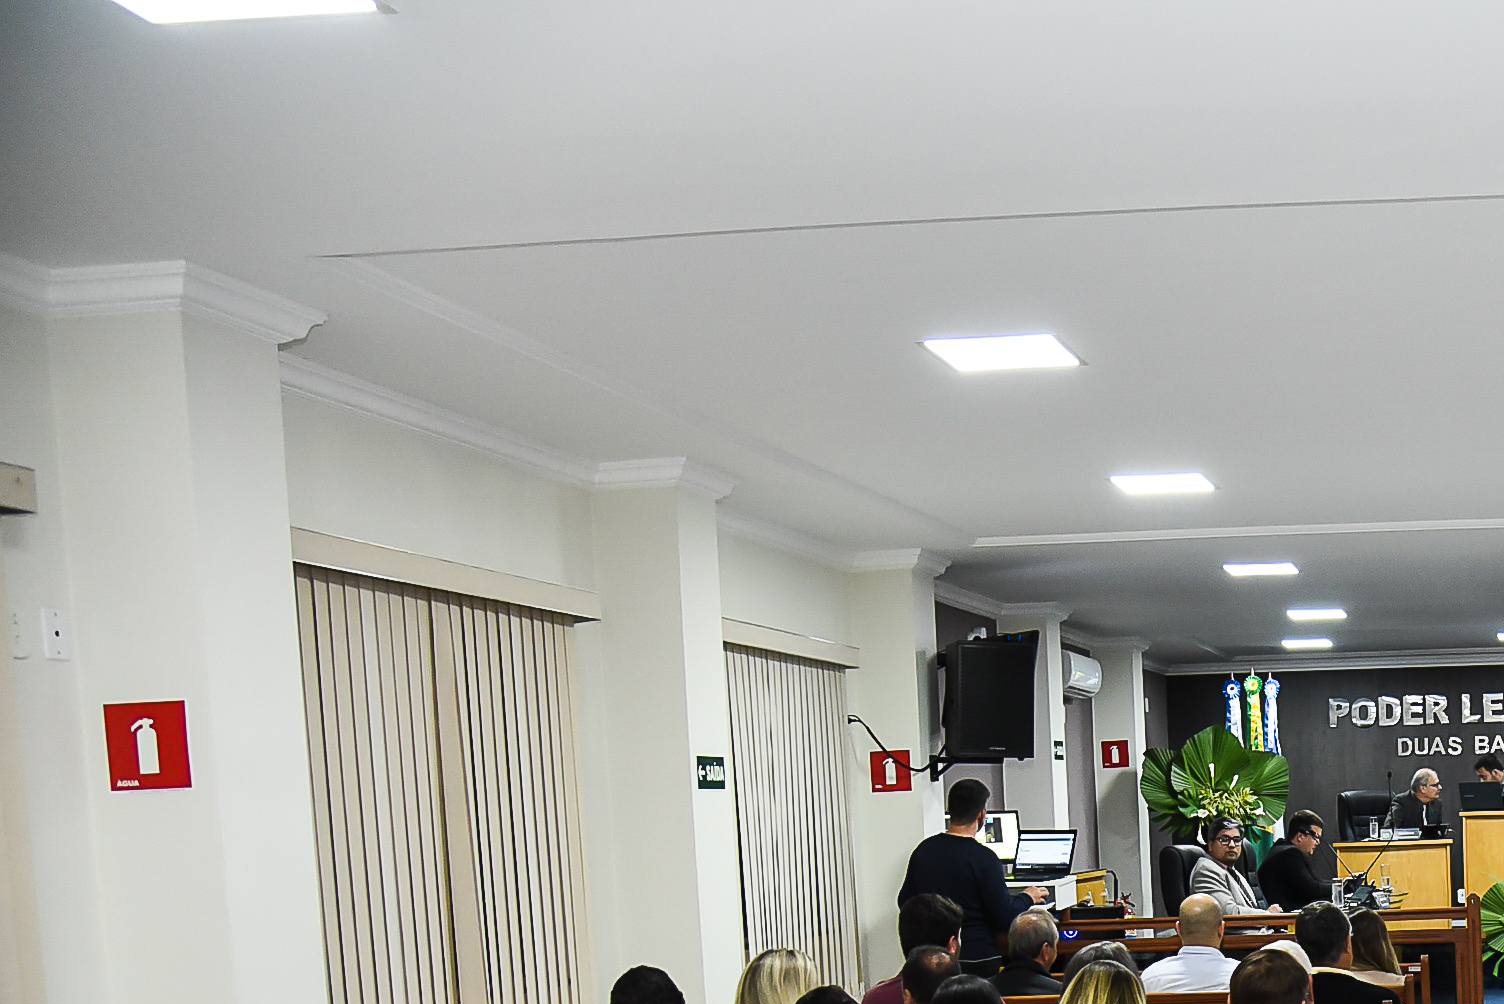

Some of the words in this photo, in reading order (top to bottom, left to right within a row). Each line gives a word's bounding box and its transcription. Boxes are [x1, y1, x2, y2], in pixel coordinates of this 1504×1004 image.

[1329, 695, 1449, 728] PODER
[1397, 736, 1463, 757] DUAS
[706, 761, 725, 781] SAÍDA
